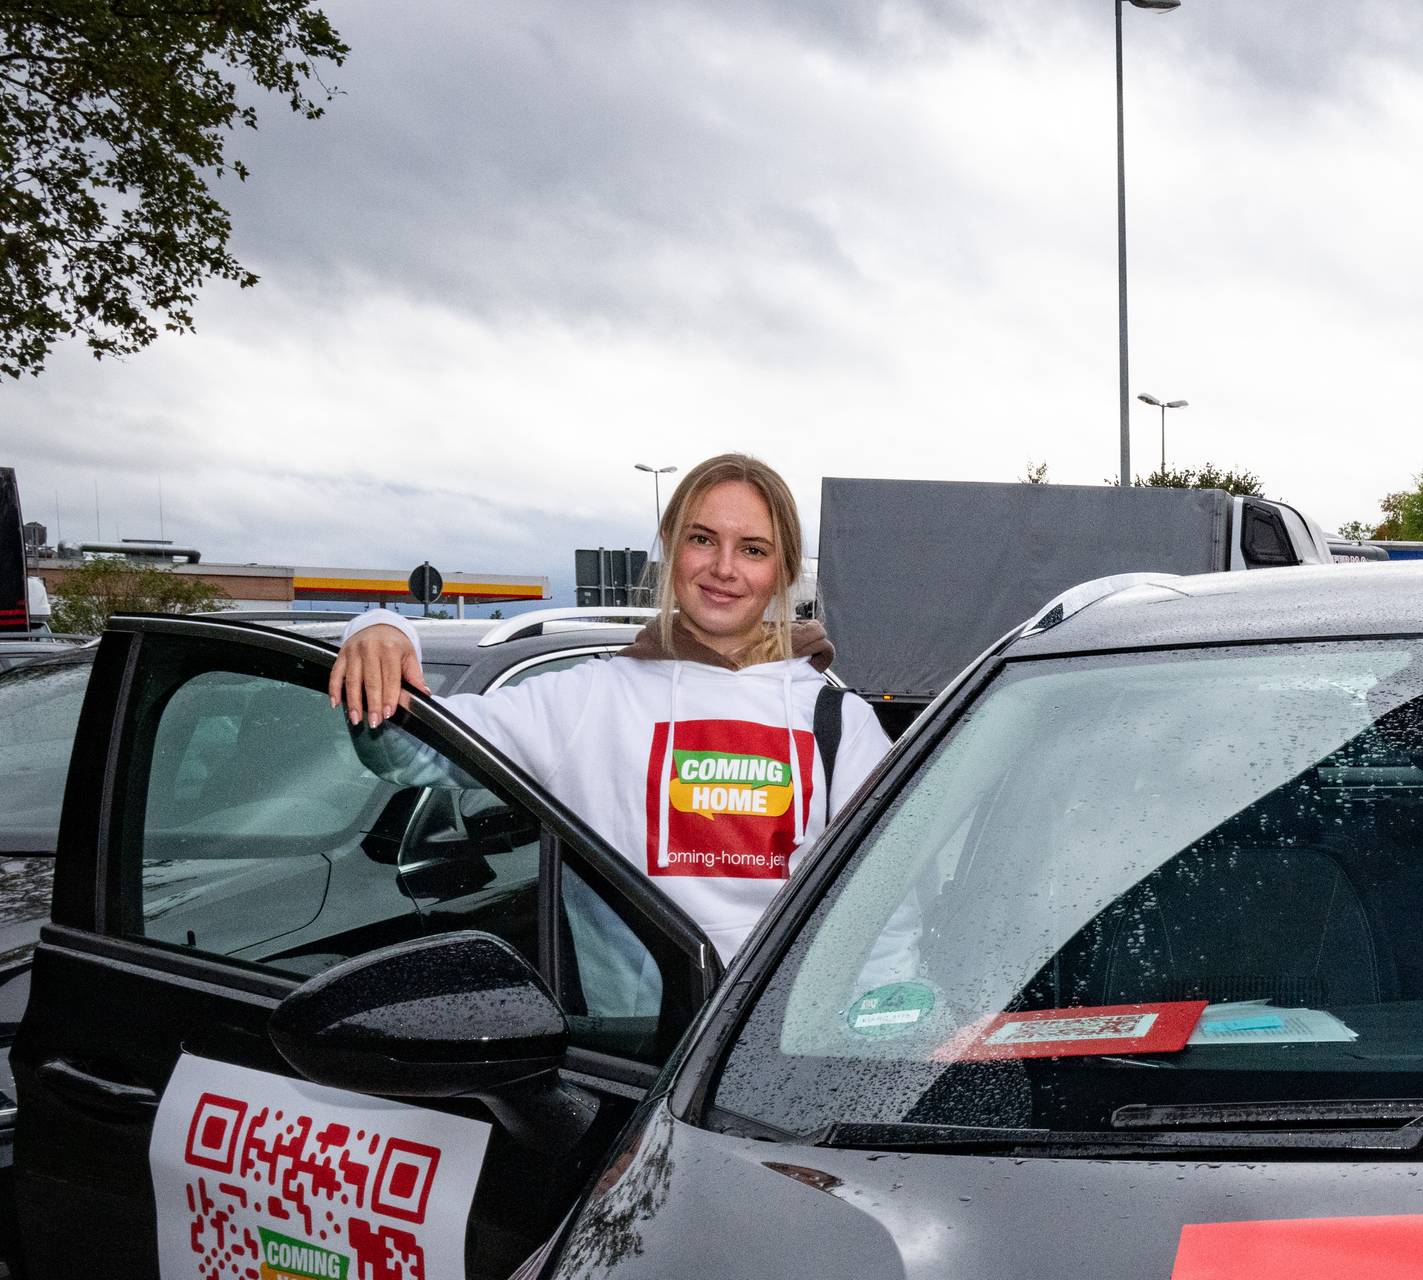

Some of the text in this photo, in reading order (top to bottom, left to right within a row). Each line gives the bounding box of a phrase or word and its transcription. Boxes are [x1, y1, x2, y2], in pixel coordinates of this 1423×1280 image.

[681, 758, 783, 783] COMING
[692, 787, 768, 813] HOME
[267, 1240, 341, 1279] COMING
